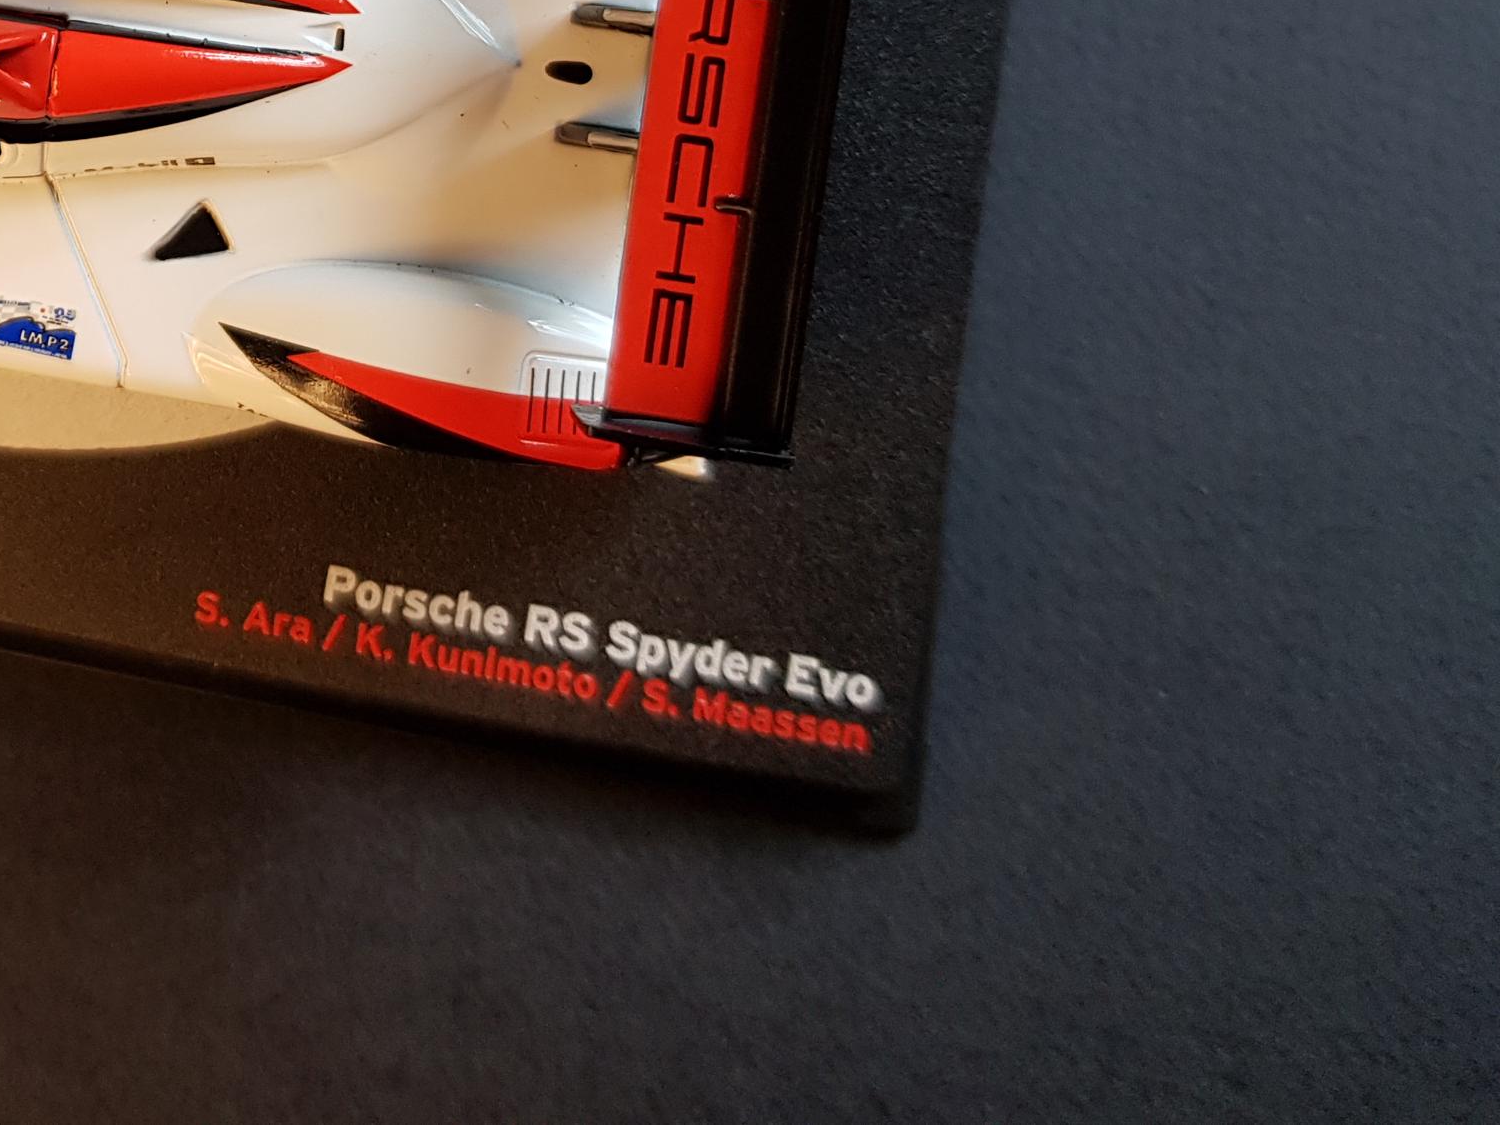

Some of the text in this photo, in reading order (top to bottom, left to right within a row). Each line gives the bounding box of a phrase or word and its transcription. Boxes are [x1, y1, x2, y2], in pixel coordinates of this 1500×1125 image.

[195, 590, 874, 754] S. Ara / K. Kunimoto / S. Maassen
[323, 564, 878, 709] Porsche RS Spyder Evo
